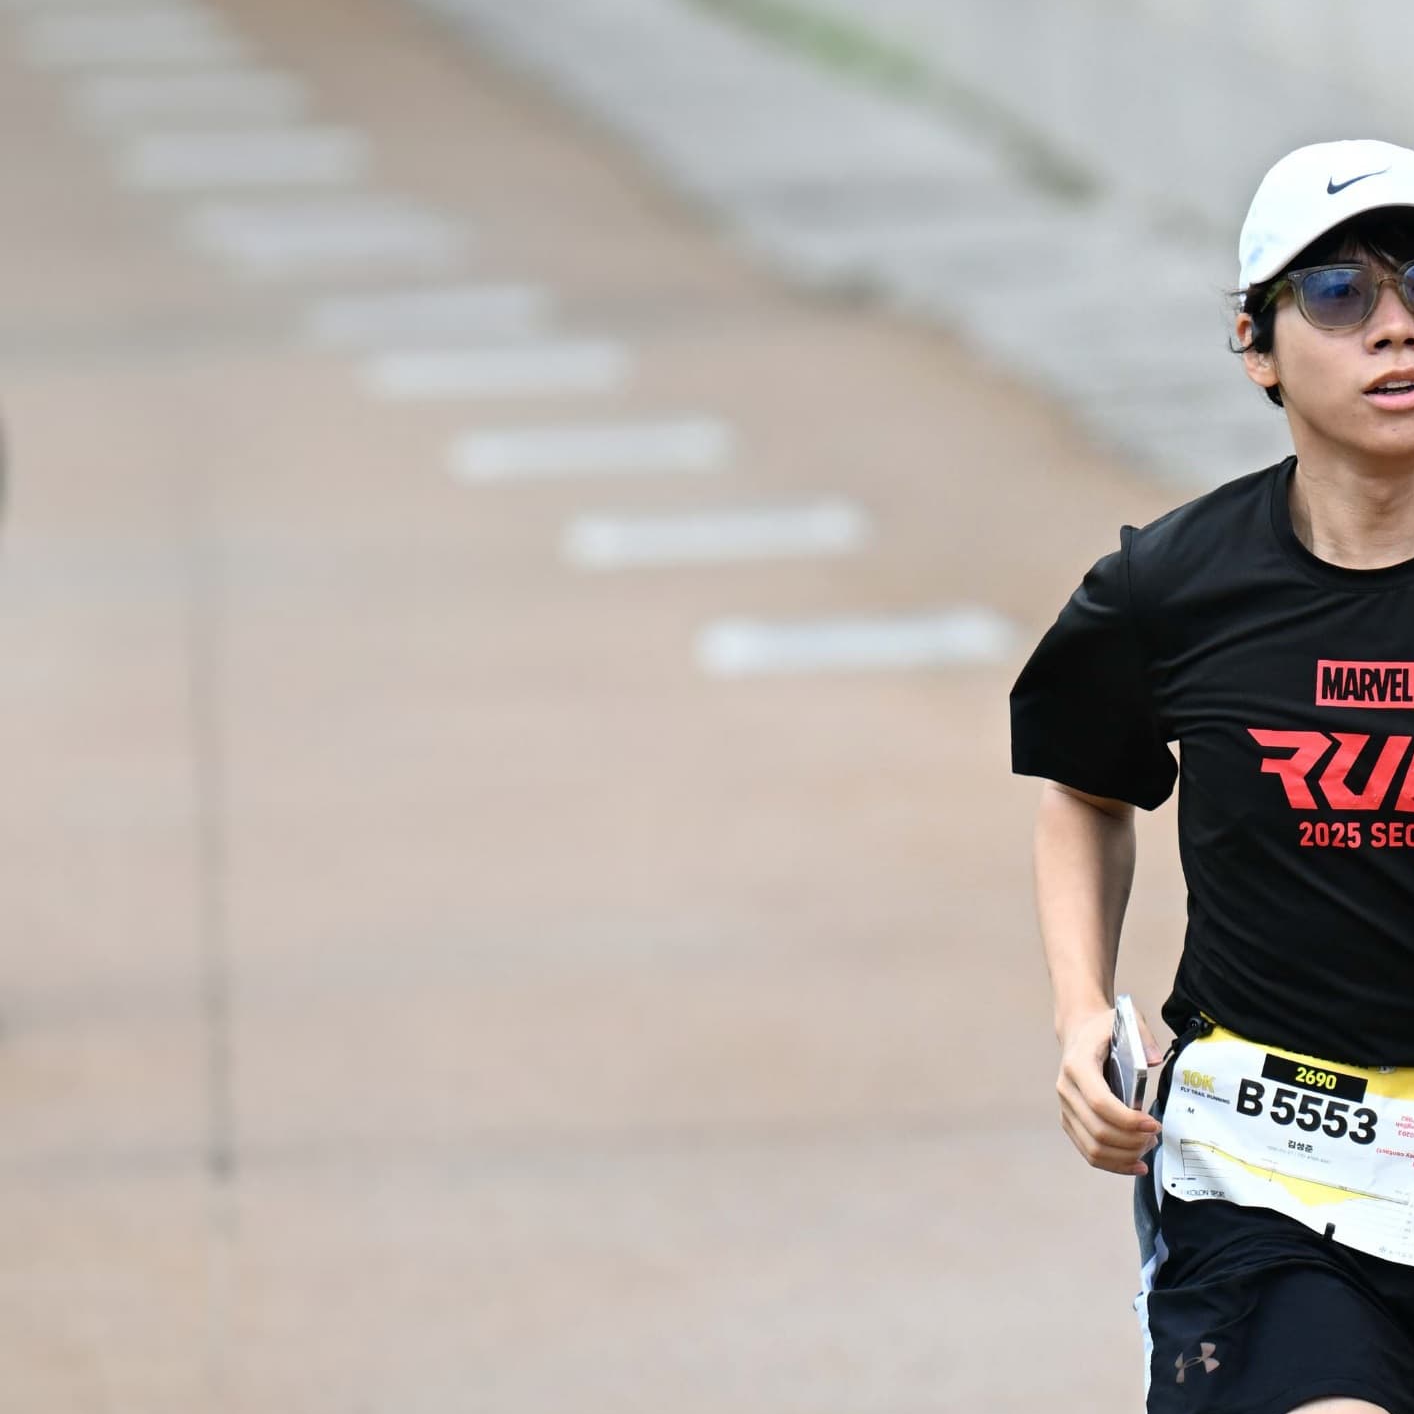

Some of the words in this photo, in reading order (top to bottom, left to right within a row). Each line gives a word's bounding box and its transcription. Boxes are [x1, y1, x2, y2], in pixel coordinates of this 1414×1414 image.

[1321, 666, 1413, 702] MARVEL
[1298, 822, 1361, 848] 2025
[1182, 1069, 1216, 1094] 10K
[1295, 1066, 1337, 1090] 2690
[1235, 1078, 1379, 1146] B5553
[1287, 1139, 1314, 1153] 김성준
